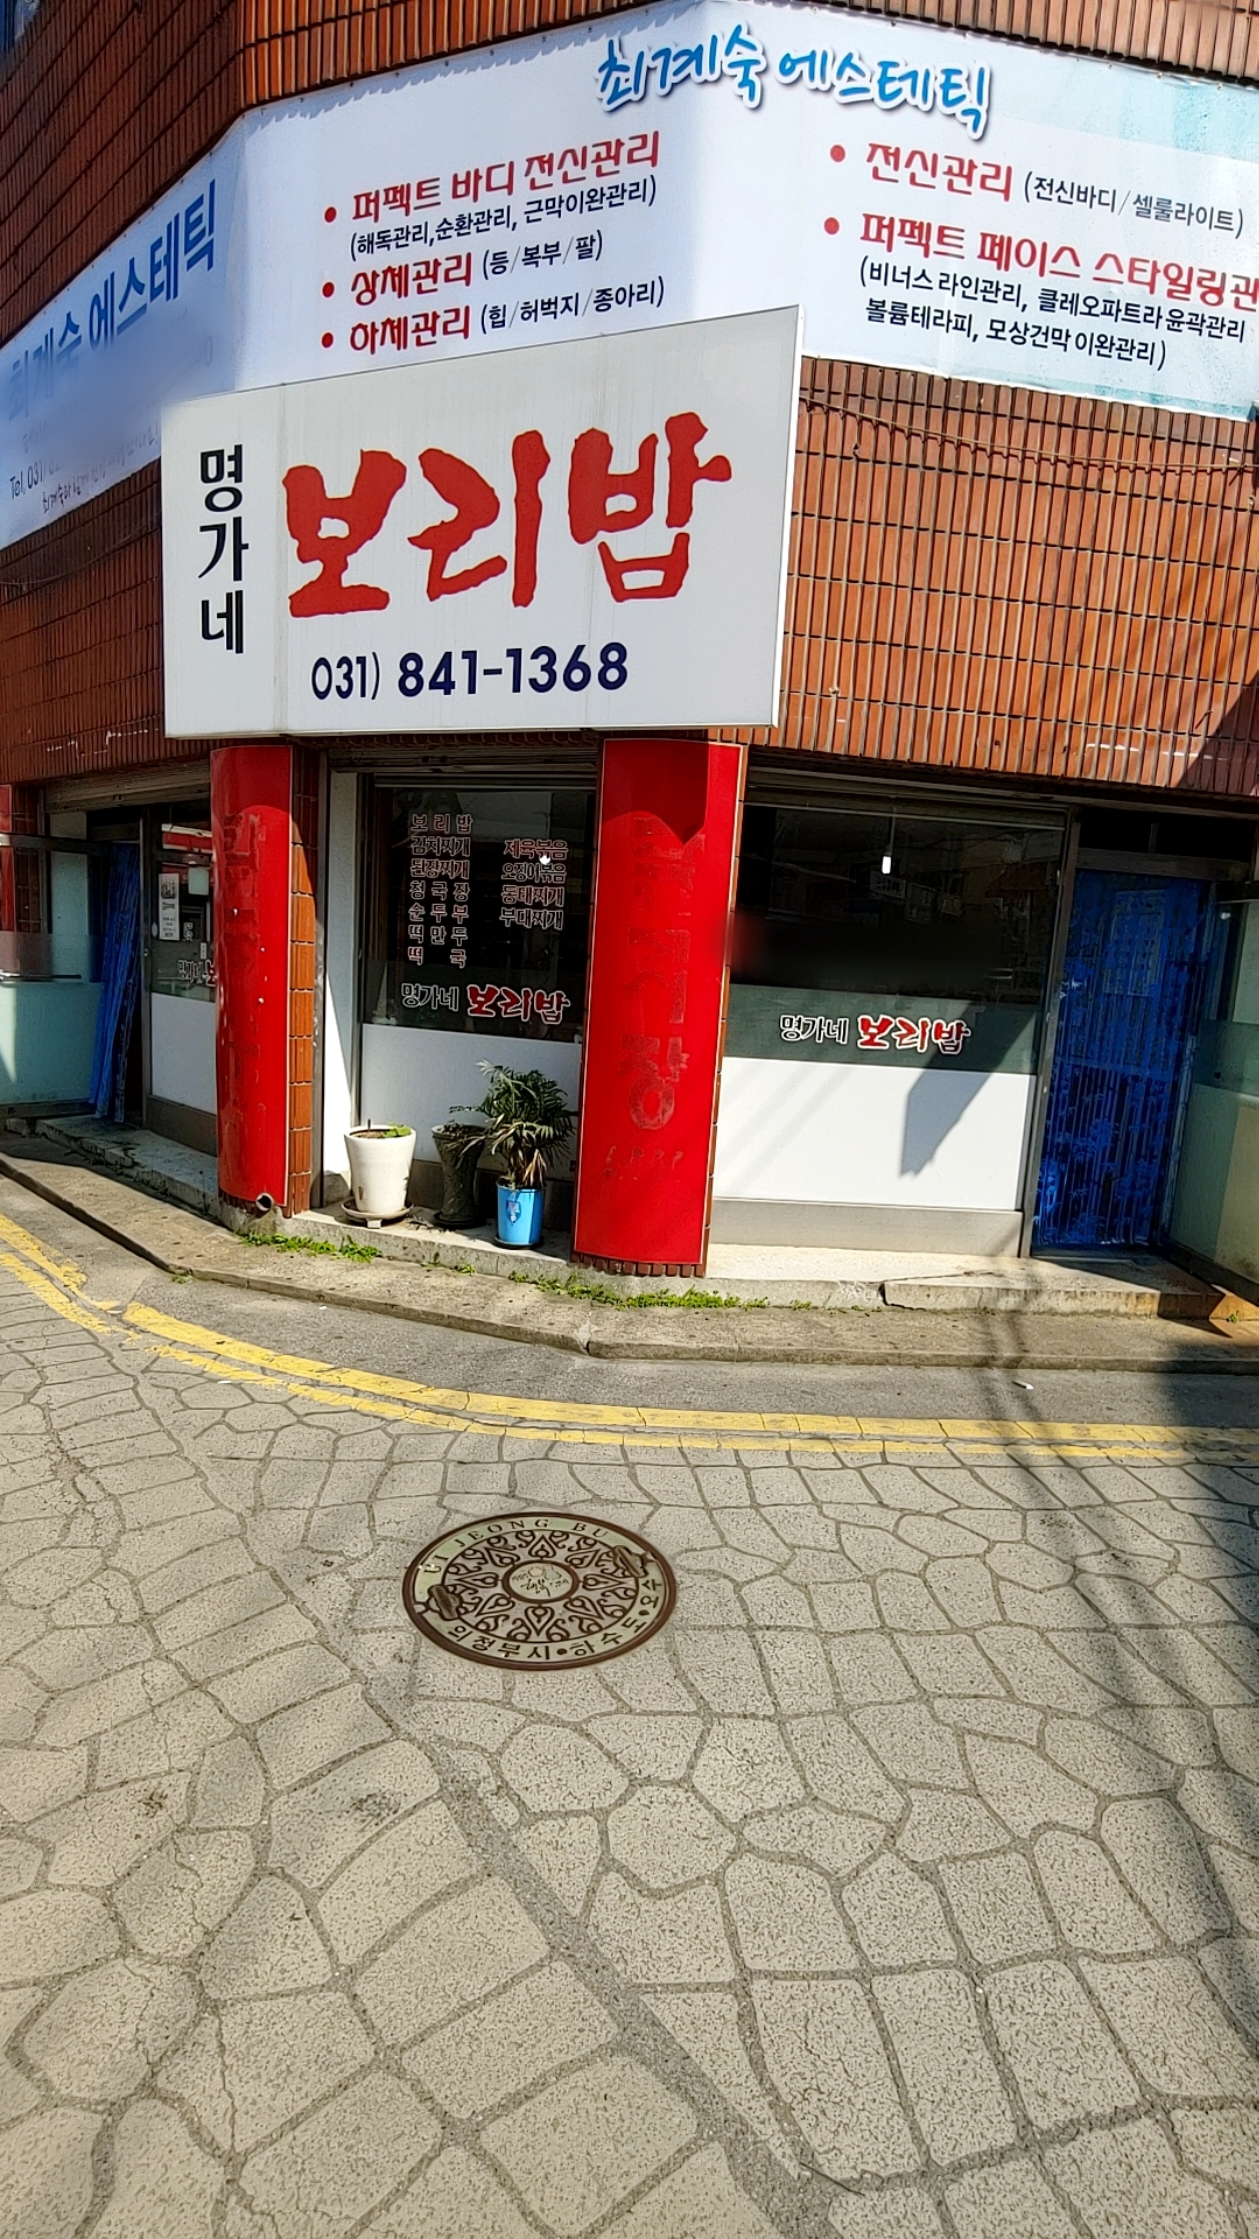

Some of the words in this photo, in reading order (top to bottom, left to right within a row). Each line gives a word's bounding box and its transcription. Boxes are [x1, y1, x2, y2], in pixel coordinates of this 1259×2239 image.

[598, 23, 764, 107] 최계숙
[779, 49, 987, 132] 에스테틱
[352, 178, 441, 221] 퍼펙트
[451, 161, 515, 201] 바디
[524, 131, 659, 190] 전신관리
[867, 143, 1012, 201] 전신관리
[524, 175, 657, 224] 근막이완관리)
[89, 178, 216, 352] 에스테틱
[860, 213, 965, 260] 퍼펙트
[977, 232, 1081, 279] 페이스
[351, 252, 472, 306] 상체관리
[350, 305, 471, 355] 하체관리
[282, 411, 733, 618] 보리밥
[198, 444, 249, 655] 명가네
[310, 651, 381, 701] 031)
[397, 641, 629, 697] 841-1368
[410, 836, 471, 857] 김치찌개
[410, 858, 470, 880] 된장찌개
[503, 838, 569, 860] 제육볶음
[501, 862, 567, 884] 오징어볶음
[501, 885, 565, 907] 동태찌개
[499, 907, 564, 931] 부대찌개
[401, 983, 459, 1011] 명가네
[467, 984, 571, 1025] 보리밥
[779, 1014, 849, 1044] 명가네
[857, 1014, 972, 1055] 보리밥
[454, 1518, 551, 1548] JEONG
[571, 1521, 610, 1539] BU
